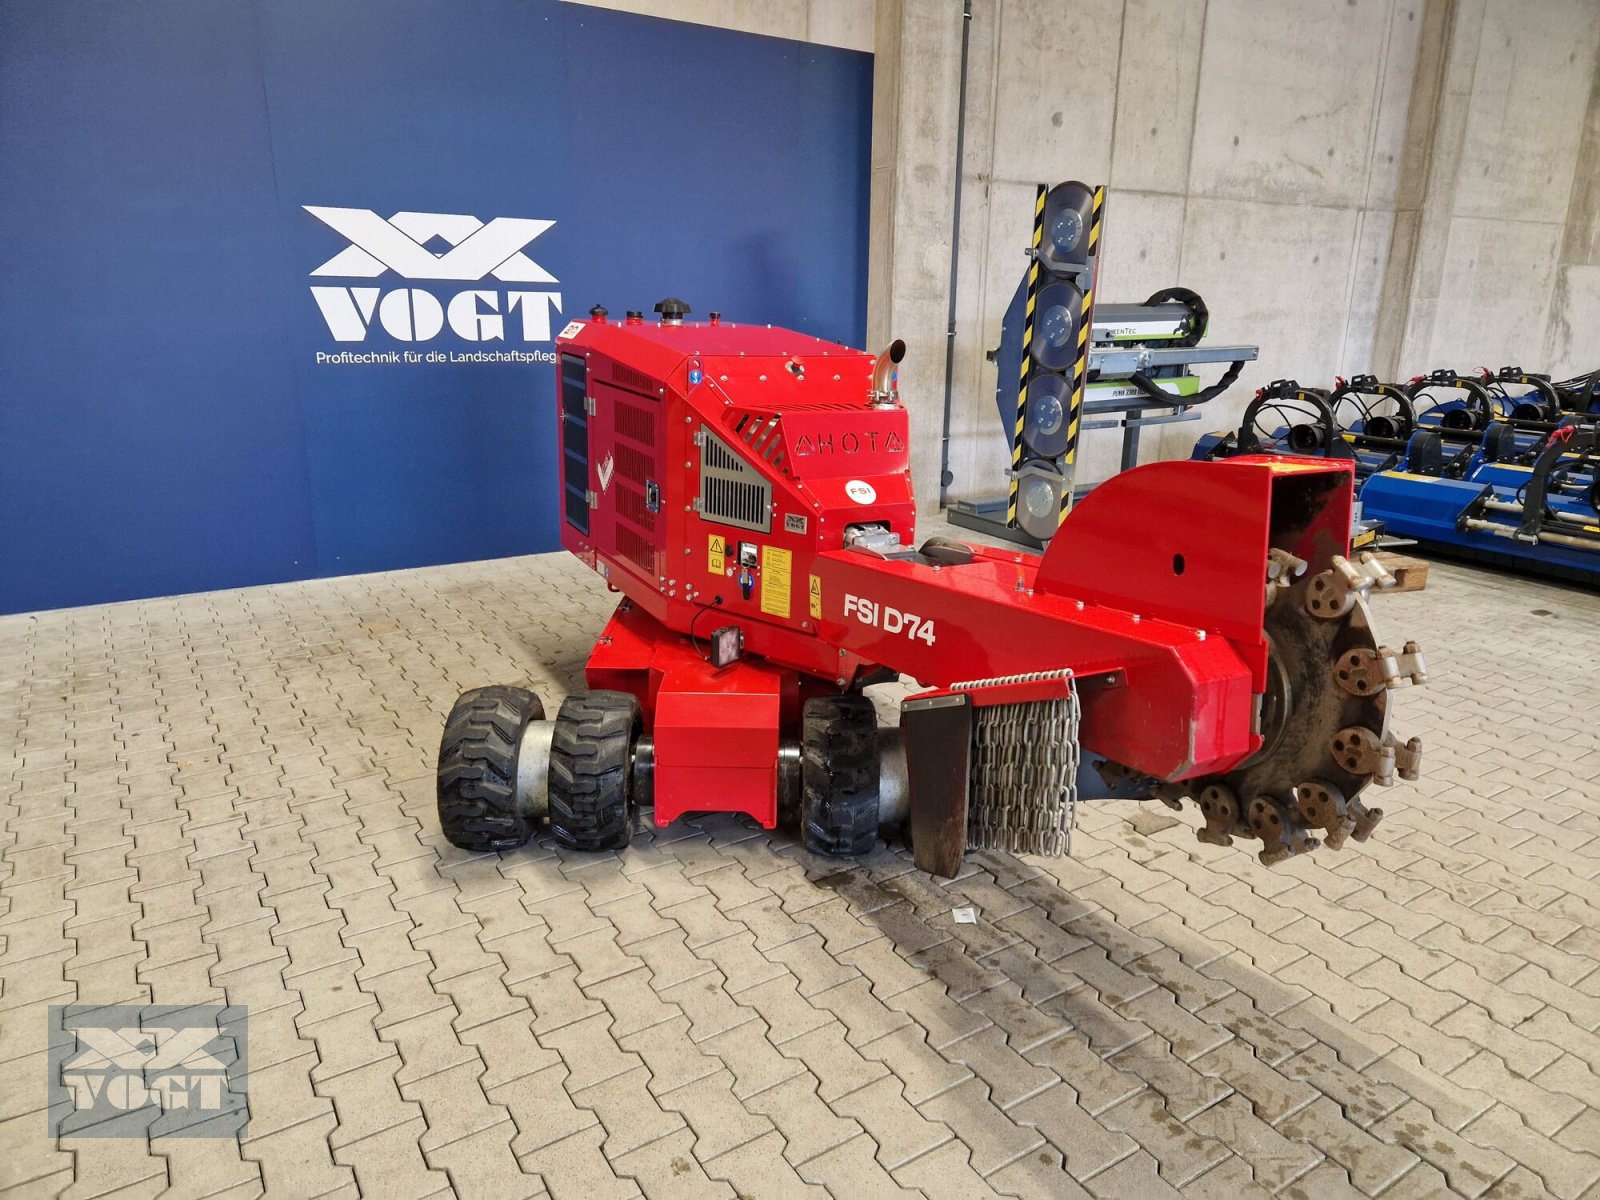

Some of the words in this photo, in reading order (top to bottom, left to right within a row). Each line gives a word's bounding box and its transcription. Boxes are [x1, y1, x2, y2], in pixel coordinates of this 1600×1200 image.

[310, 286, 562, 341] VOGT
[316, 351, 400, 363] Profitechnik
[404, 351, 422, 363] für
[426, 351, 446, 362] die
[450, 350, 557, 364] Landschaftspfleg
[818, 432, 878, 454] HOT
[843, 594, 878, 627] FSI
[884, 606, 936, 646] D74
